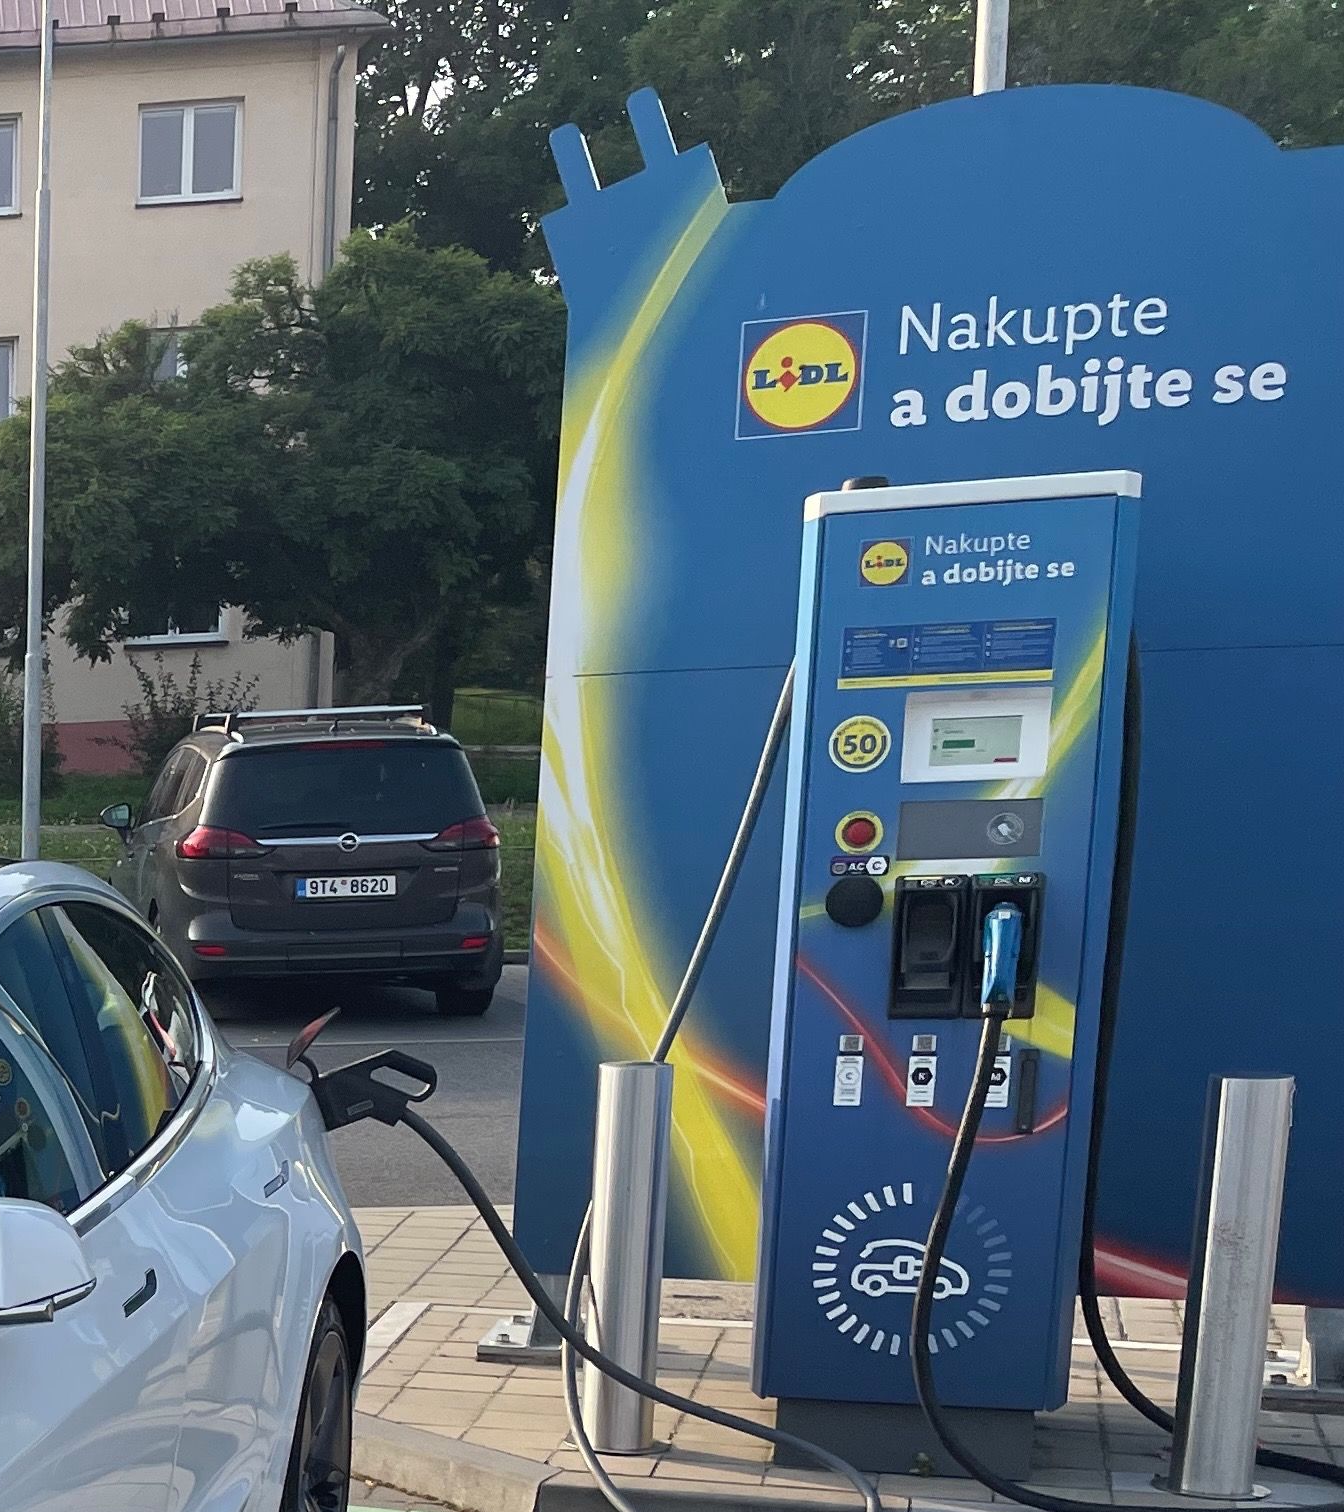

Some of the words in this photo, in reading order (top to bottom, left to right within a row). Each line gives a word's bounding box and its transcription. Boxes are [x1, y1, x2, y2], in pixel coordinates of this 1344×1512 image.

[899, 293, 1169, 356] Nakupte
[890, 388, 927, 428] a
[945, 356, 1193, 426] dobijte
[1212, 361, 1287, 405] se
[925, 532, 1032, 557] Nakupte
[921, 568, 937, 586] a
[943, 559, 1040, 587] dobijte
[1046, 561, 1076, 579] se
[843, 733, 878, 756] 50
[873, 860, 882, 871] C
[309, 879, 339, 895] 9T4
[349, 877, 390, 894] 8620
